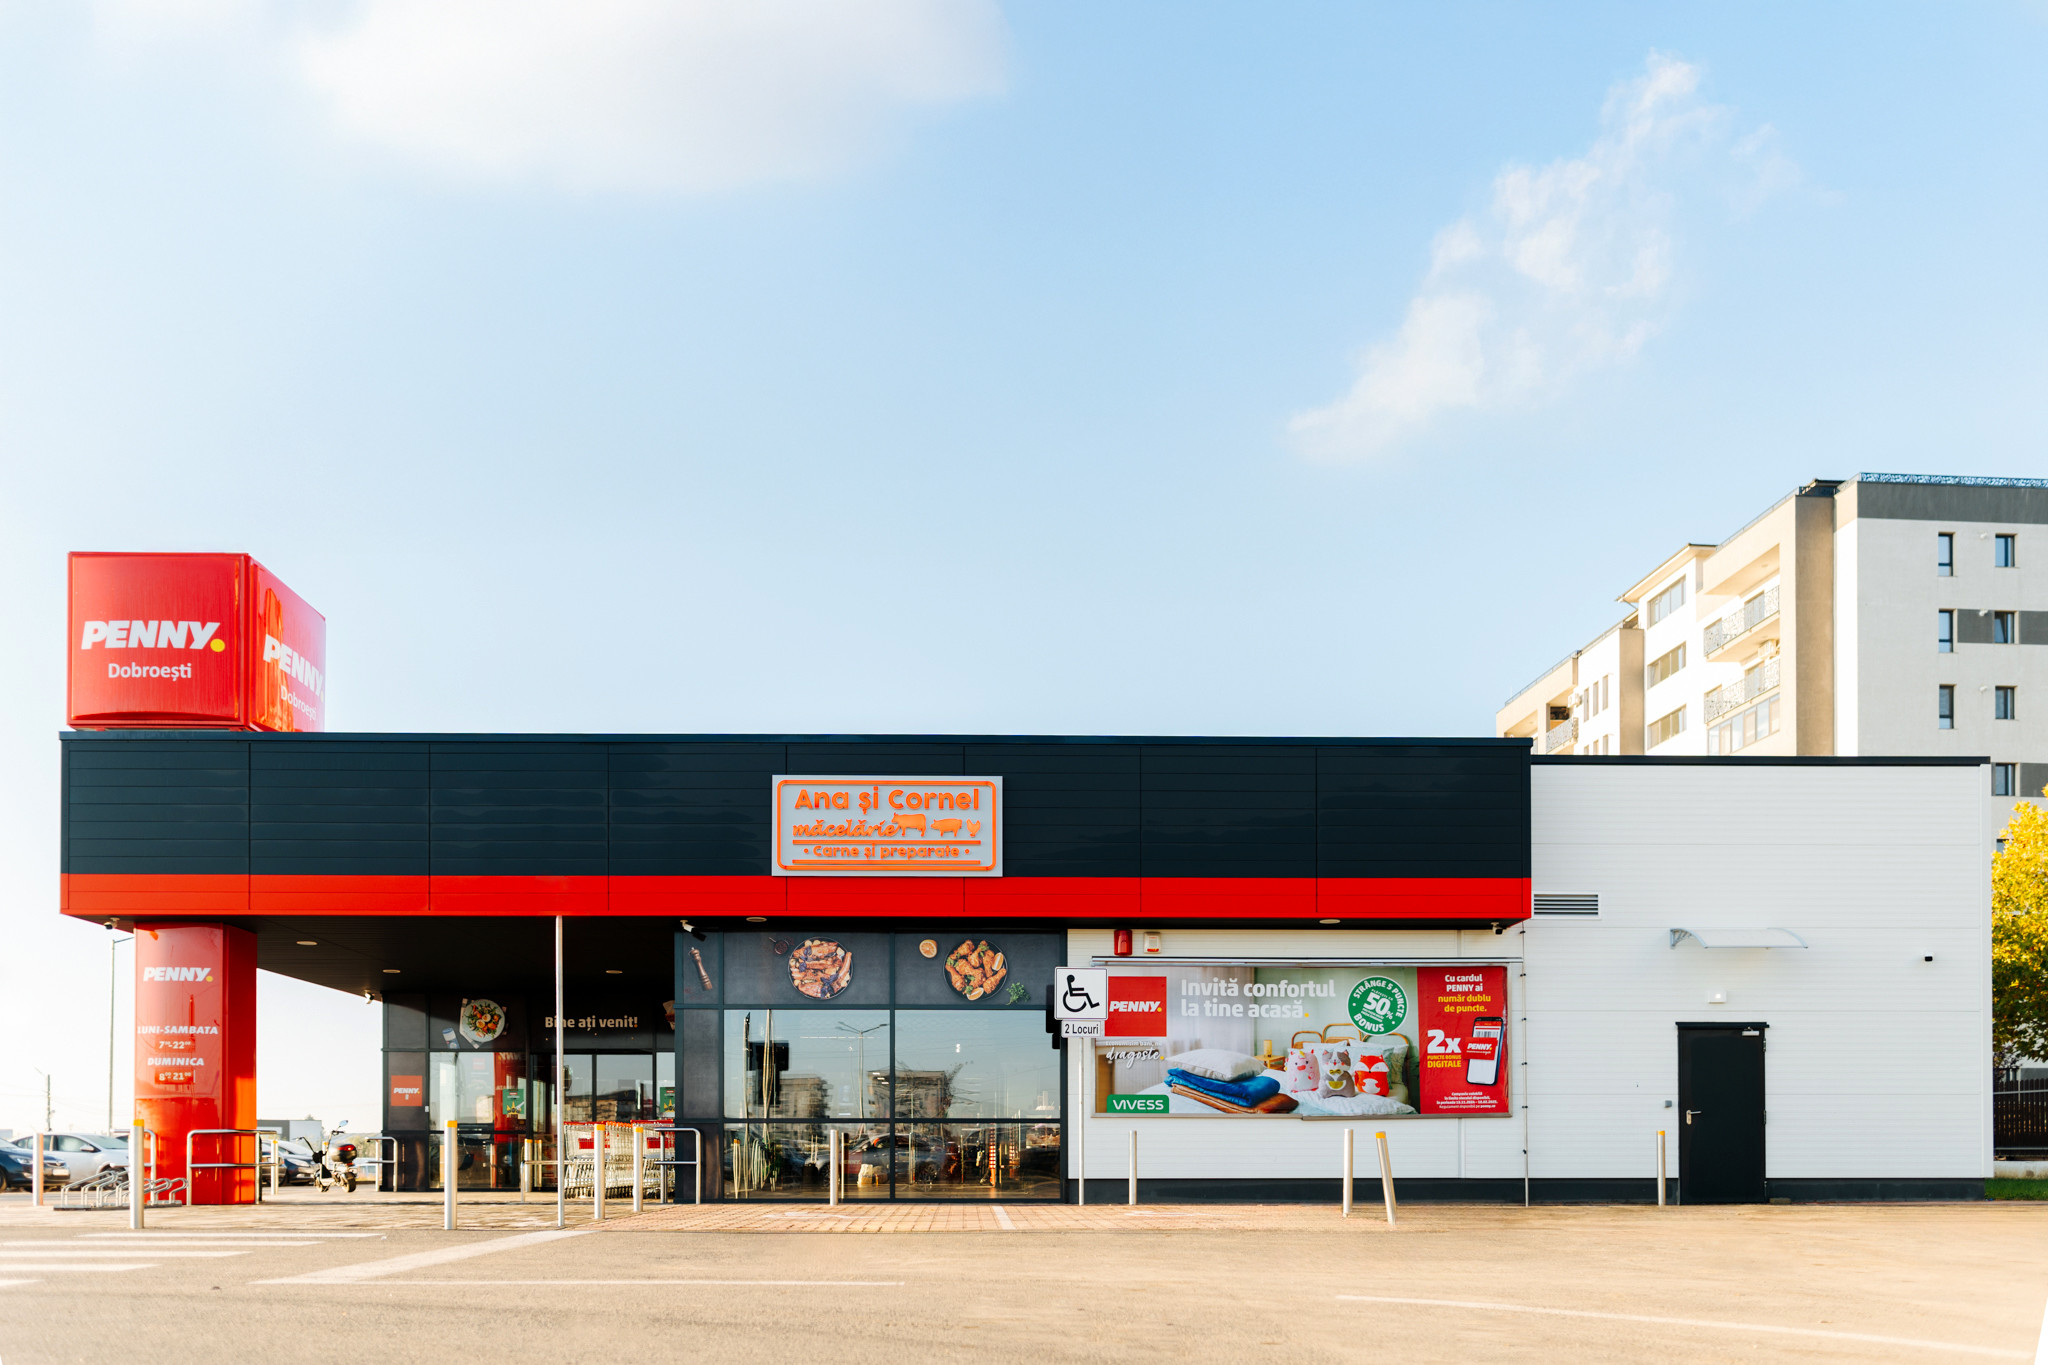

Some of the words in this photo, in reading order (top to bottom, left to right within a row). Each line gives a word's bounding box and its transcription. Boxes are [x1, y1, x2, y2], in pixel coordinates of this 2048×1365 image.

[108, 662, 192, 682] Dobroești
[794, 789, 849, 809] Ana
[859, 786, 879, 814] și
[888, 788, 979, 810] Cornel
[793, 819, 899, 838] măcelărie
[813, 845, 860, 857] Carne
[864, 842, 876, 860] și
[880, 845, 959, 860] preparate
[1445, 974, 1455, 982] Cu
[1456, 974, 1483, 982] cardul
[1181, 977, 1239, 997] Invită
[1243, 979, 1336, 998] confortul
[1446, 984, 1474, 992] PENNY
[1475, 983, 1483, 992] ai
[1353, 979, 1387, 999] STRÂNGE
[1391, 987, 1405, 1018] PUNCTE
[1438, 994, 1465, 1002] număr
[1466, 994, 1491, 1002] dublu
[1181, 998, 1199, 1017] la
[1204, 998, 1243, 1017] tine
[1248, 999, 1309, 1018] acasă.
[1444, 1004, 1455, 1012] de
[1456, 1005, 1487, 1013] puncte.
[578, 1015, 596, 1031] ați
[599, 1015, 638, 1028] venit!
[1064, 1024, 1070, 1034] 2
[1072, 1023, 1099, 1034] Locuri
[1354, 1013, 1384, 1032] BONUS
[1427, 1029, 1461, 1053] 2x
[147, 1057, 204, 1066] DUMINICA
[1427, 1060, 1462, 1068] DIGITALE
[1113, 1099, 1164, 1110] VIVESS
